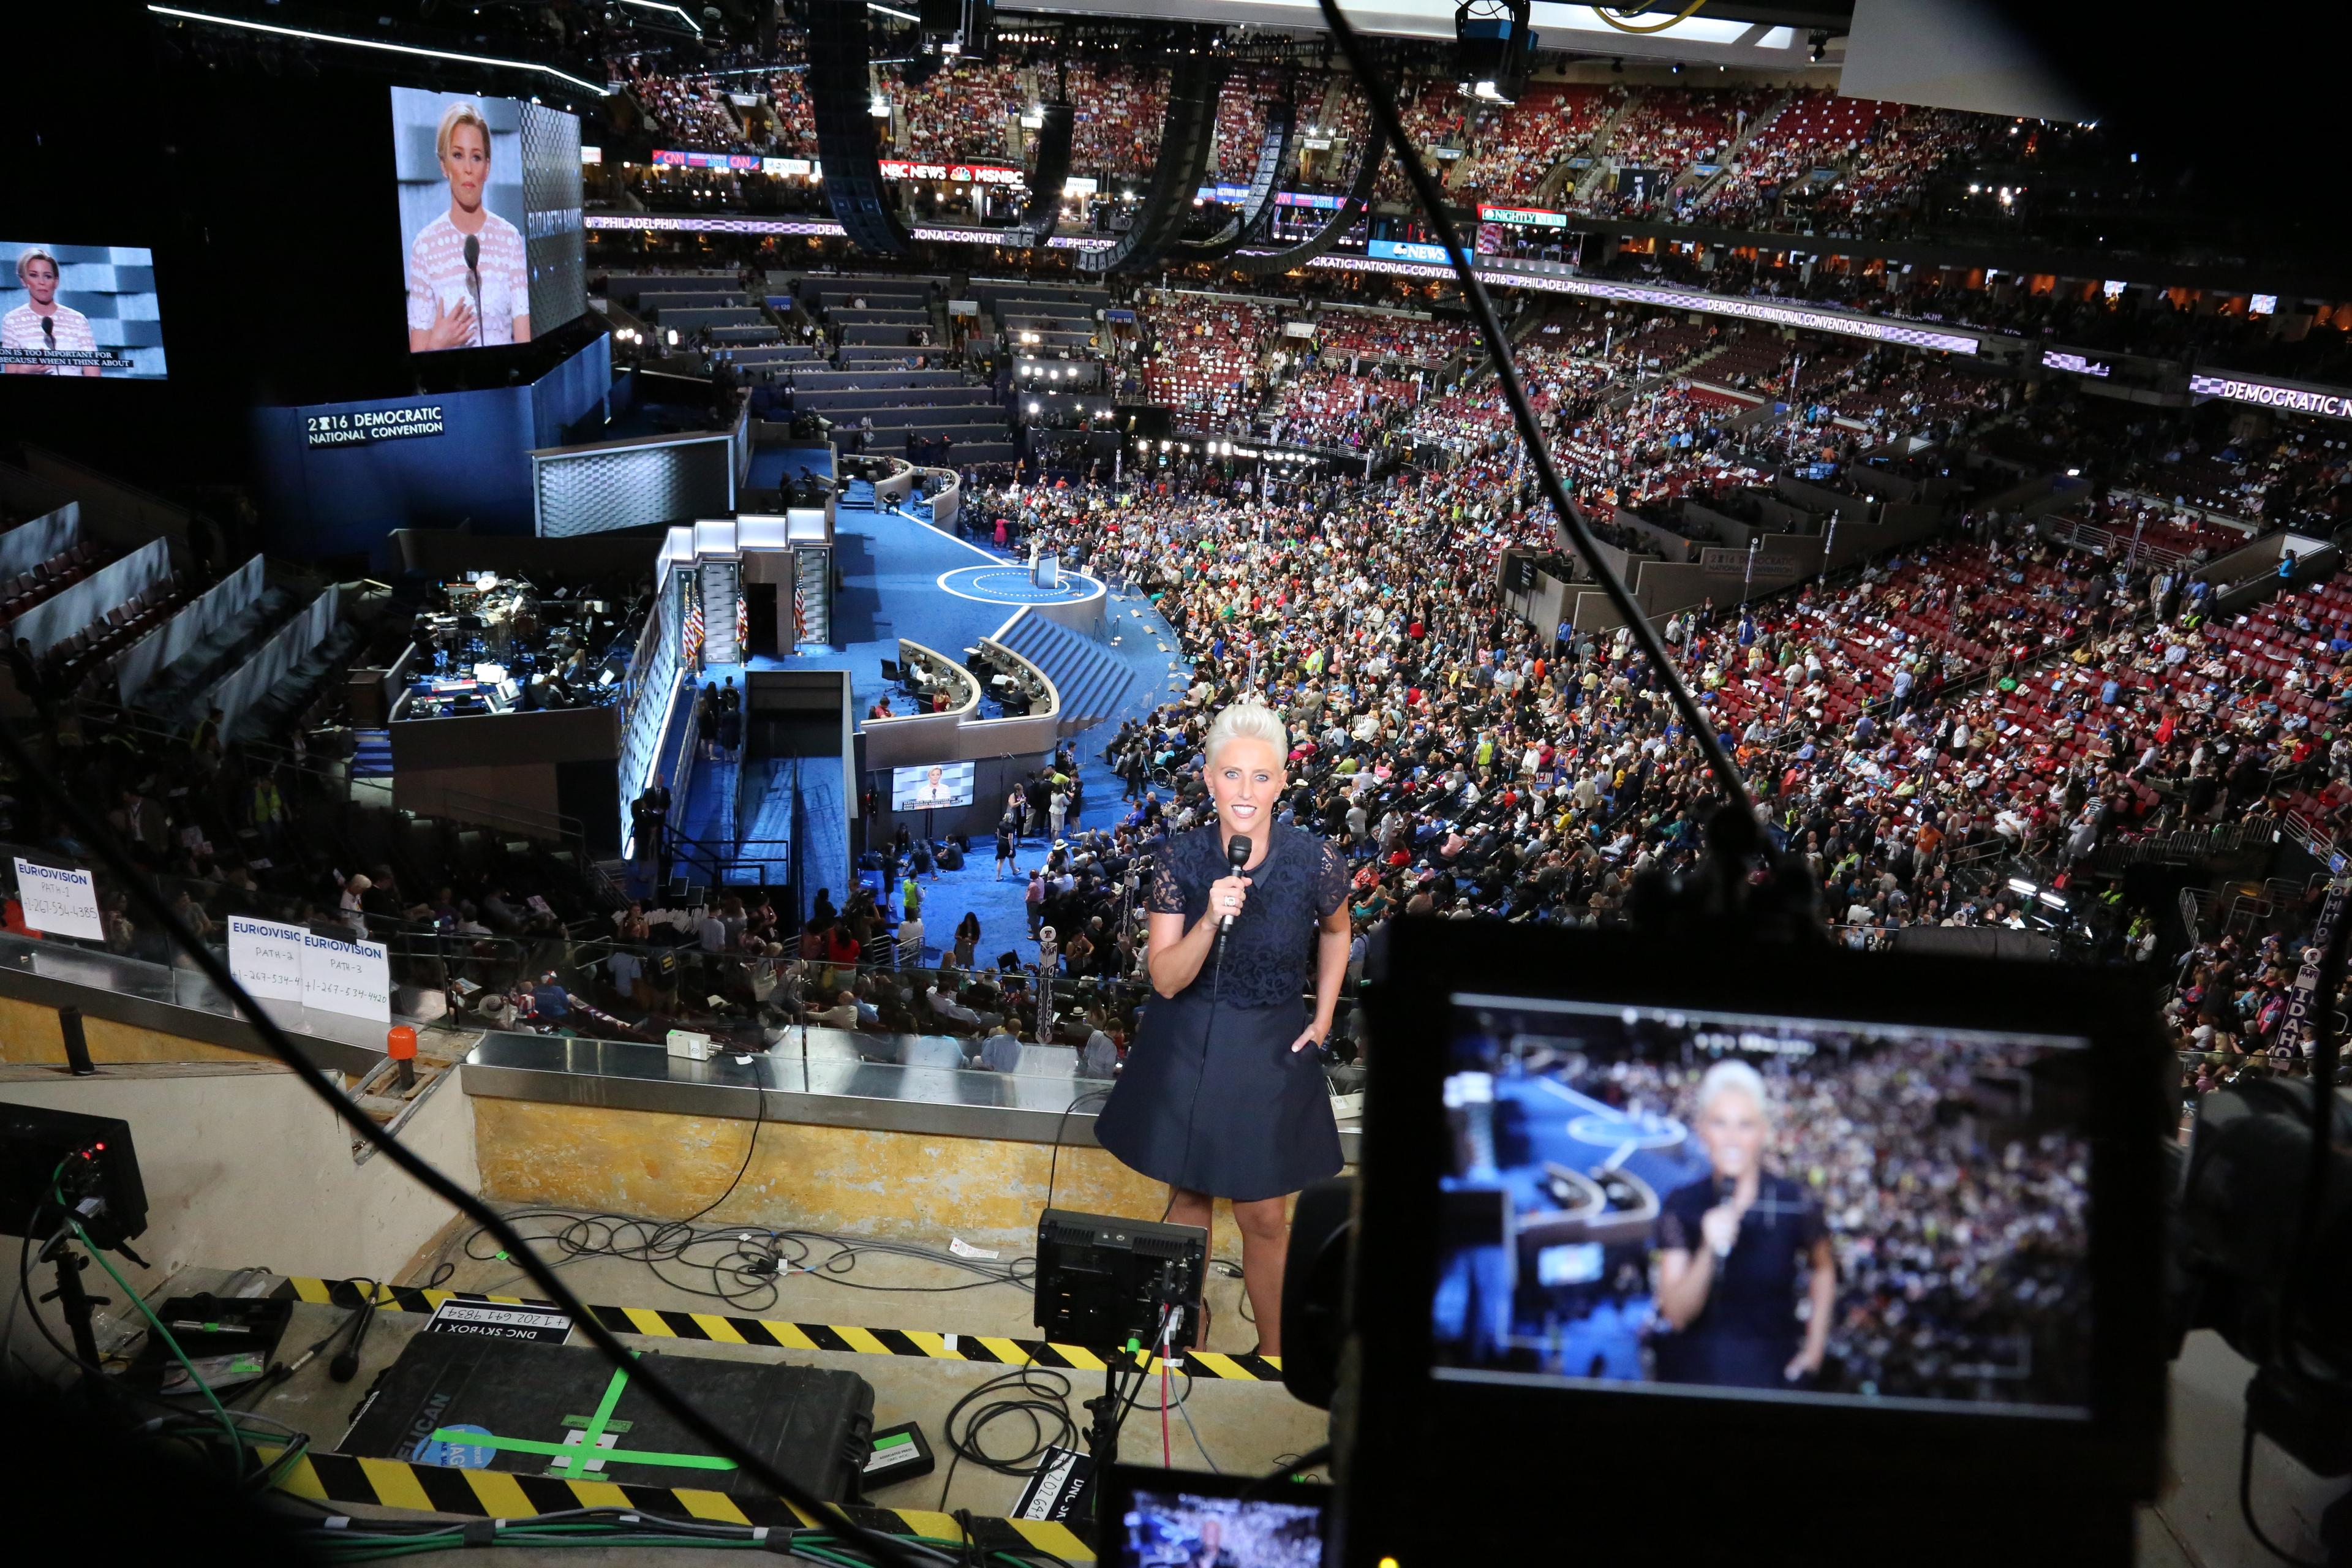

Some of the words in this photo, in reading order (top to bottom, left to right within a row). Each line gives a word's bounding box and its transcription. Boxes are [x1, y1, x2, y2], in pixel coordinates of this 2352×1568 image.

[664, 153, 684, 164] CNN
[730, 156, 750, 167] CNN
[880, 163, 908, 178] NBC
[910, 165, 946, 179] NEWS
[974, 168, 1023, 184] MSNBC
[1217, 187, 1235, 197] ACTION
[1236, 189, 1250, 197] NEW
[1275, 194, 1291, 203] NN
[528, 209, 562, 239] ELIZABETH
[603, 217, 680, 230] PHILADELPHIA
[1495, 210, 1536, 223] NIGHTLY
[1539, 215, 1564, 225] NEWS
[914, 230, 950, 241] IONAL
[952, 232, 1004, 244] CONVEN
[1407, 245, 1446, 261] NEWS
[1306, 257, 1352, 268] CRATIC
[1354, 262, 1408, 274] NATIONAL
[1485, 273, 1506, 284] 2016
[1518, 276, 1589, 294] PHILADELPHIA
[1707, 300, 1763, 317] DEMOCRATIC
[1764, 308, 1803, 324] NATIONAL
[1804, 313, 1862, 333] CONVENTION
[1862, 324, 1882, 337] 2016
[2223, 380, 2338, 414] DEMOCRATIC
[354, 407, 442, 427] DEMOCRATIC
[309, 430, 366, 444] NATIONAL
[371, 422, 443, 439] CONVENTION
[1579, 726, 1588, 758] IOWA
[2317, 887, 2342, 937] OHIO
[2275, 988, 2309, 1058] IDAHO
[518, 1314, 539, 1324] 202
[448, 1324, 503, 1336] SKYBOX
[506, 1329, 537, 1339] DNC
[396, 1392, 451, 1463] ELICAN
[1039, 1474, 1062, 1496] 202
[1065, 1479, 1085, 1502] DNC
[1054, 1506, 1069, 1523] SK
